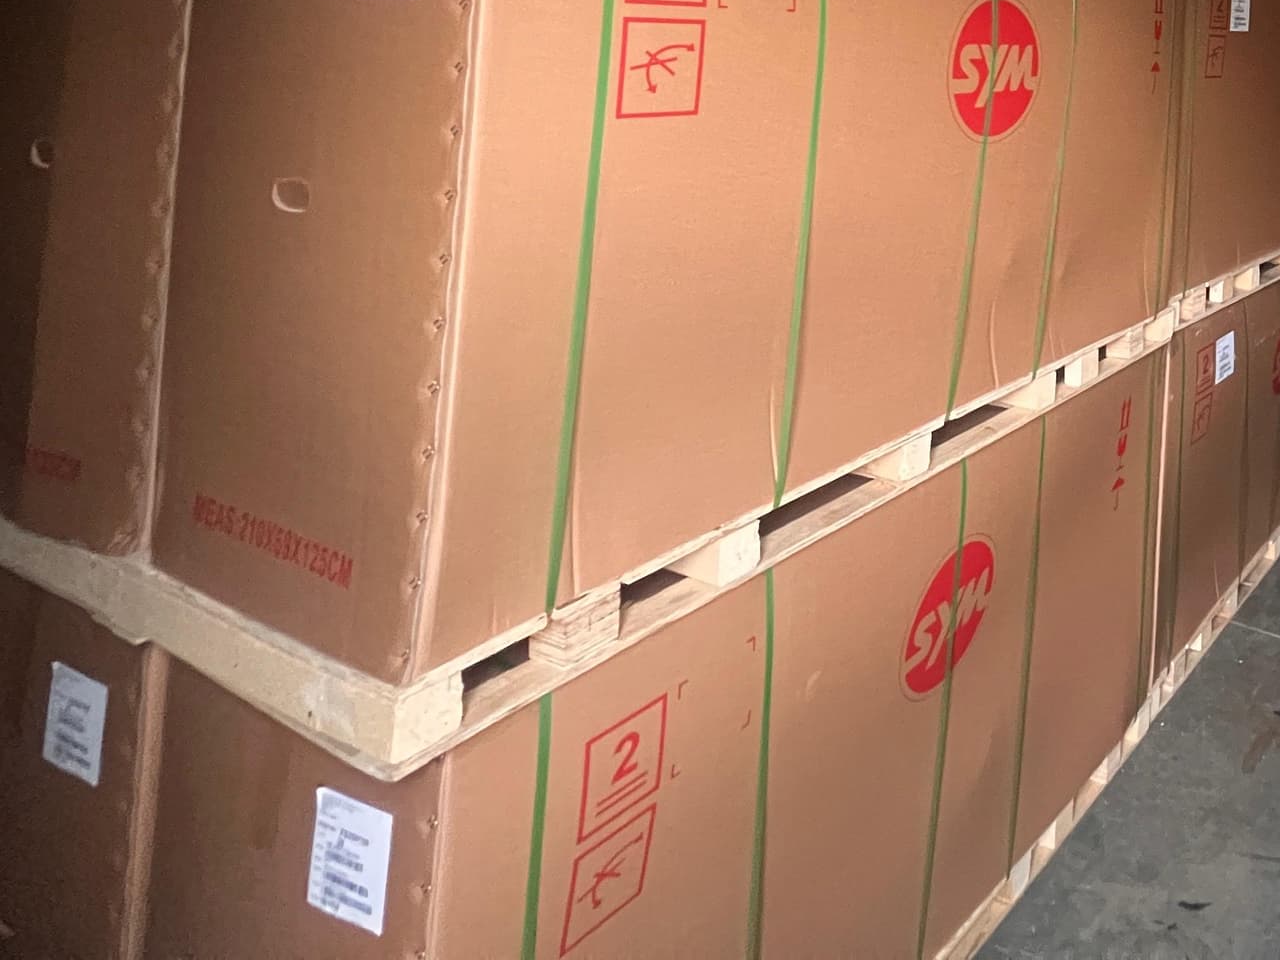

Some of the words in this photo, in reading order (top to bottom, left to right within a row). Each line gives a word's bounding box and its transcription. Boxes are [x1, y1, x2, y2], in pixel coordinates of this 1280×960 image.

[951, 43, 1041, 109] SYM
[902, 566, 990, 672] SYM
[611, 731, 640, 784] 2
